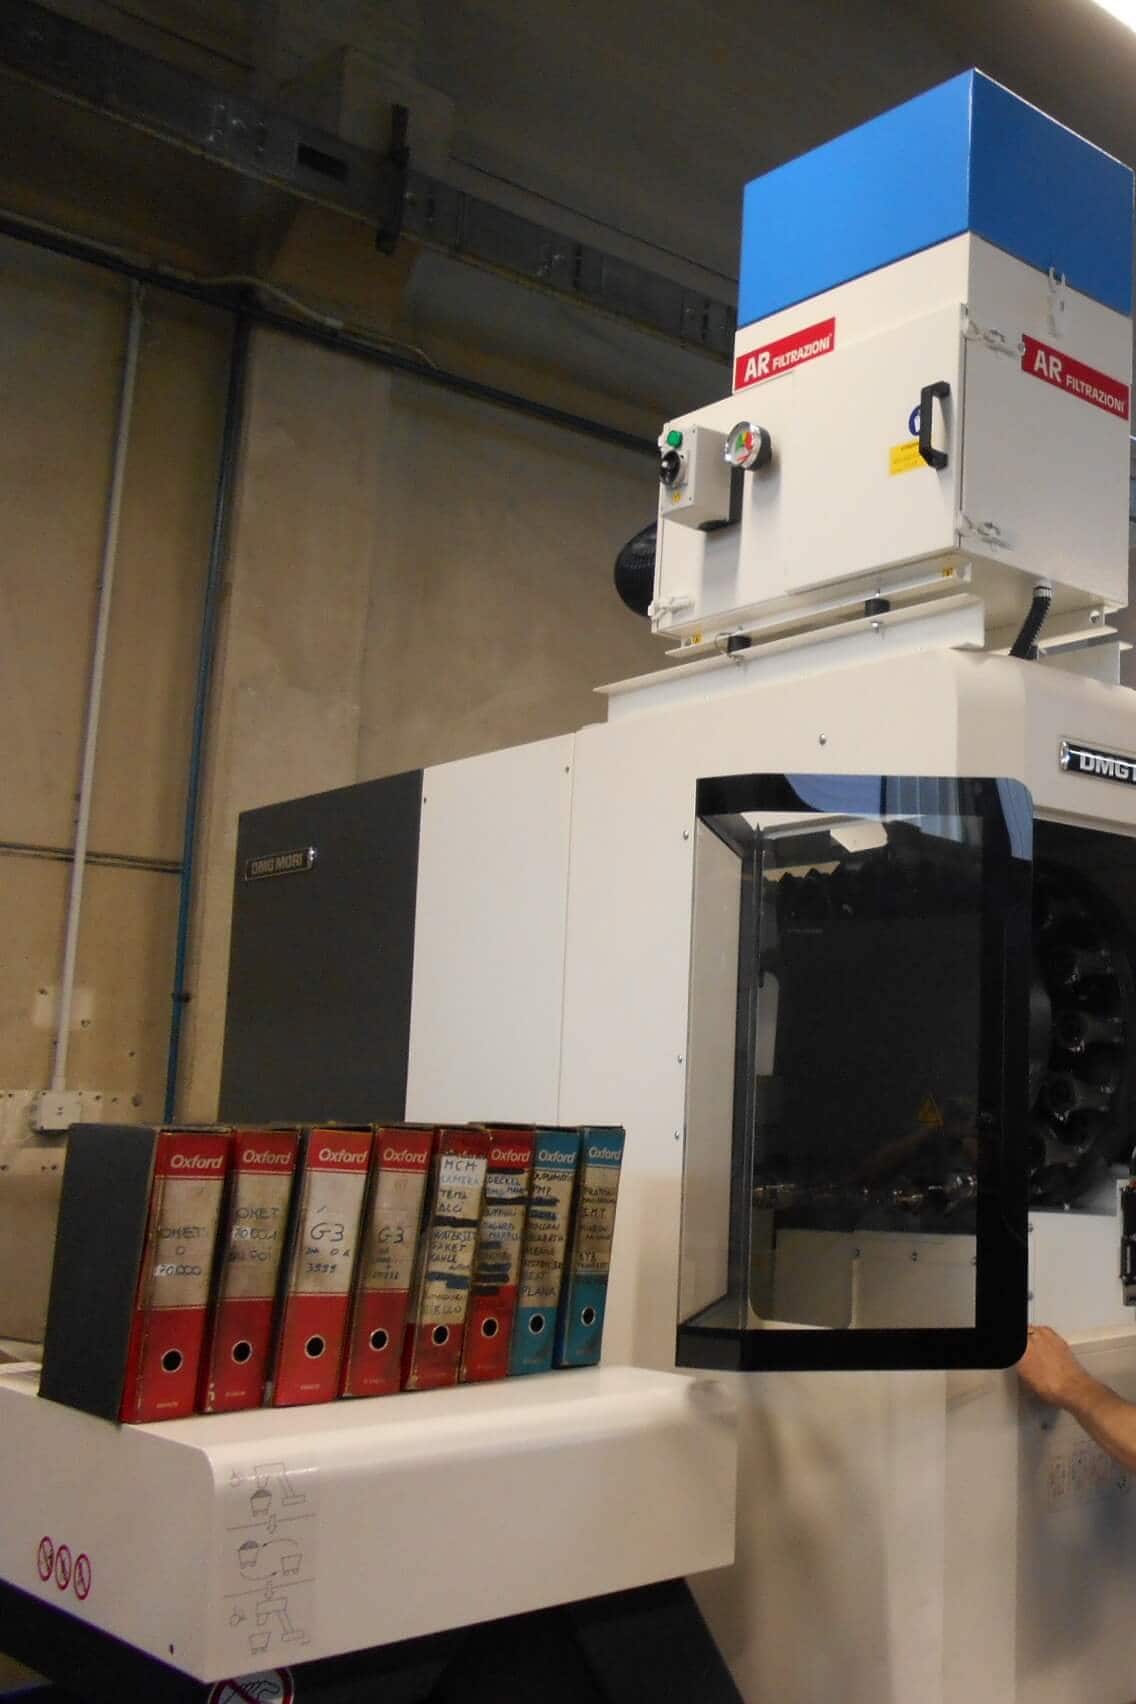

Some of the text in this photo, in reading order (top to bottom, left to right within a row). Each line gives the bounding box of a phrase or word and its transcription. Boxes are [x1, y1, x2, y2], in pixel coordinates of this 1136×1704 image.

[744, 335, 831, 383] AR FILTRAZIONI
[1033, 348, 1125, 413] AR FILTRAZIONI
[1080, 751, 1129, 779] DMG
[242, 1150, 292, 1165] Oxford
[318, 1147, 368, 1164] Oxford
[383, 1149, 427, 1164] Oxford
[490, 1148, 531, 1163] Oxford
[538, 1150, 577, 1164] Oxford
[588, 1146, 621, 1160] Oxford
[170, 1154, 224, 1169] Oxford
